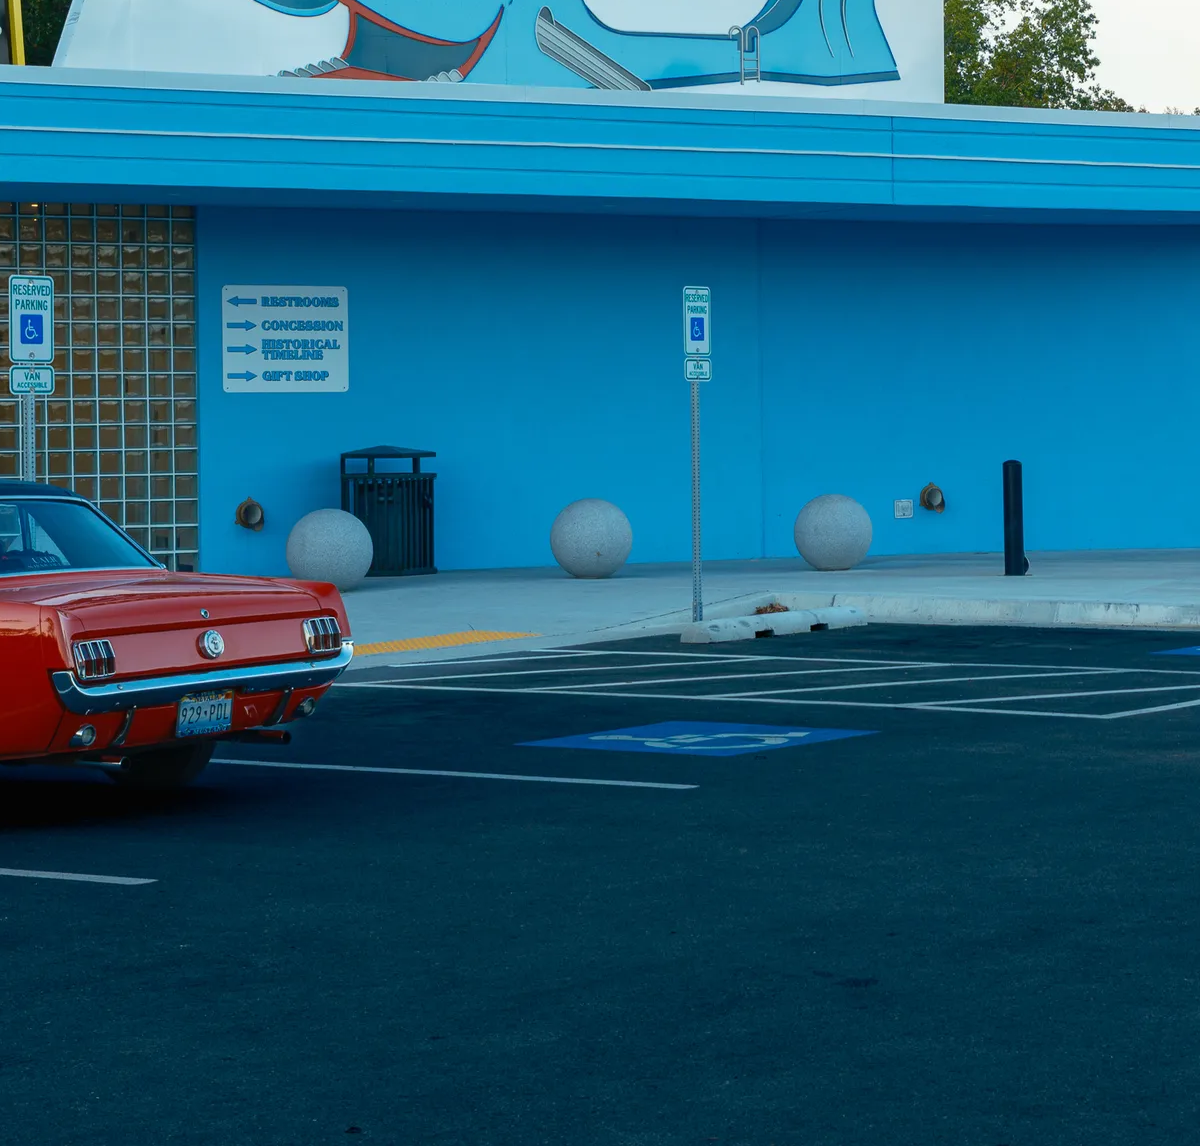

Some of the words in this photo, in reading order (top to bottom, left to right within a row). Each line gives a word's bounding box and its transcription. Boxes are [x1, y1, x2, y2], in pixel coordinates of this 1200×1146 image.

[12, 284, 51, 296] RESERVED
[261, 296, 340, 308] RESTROOMS
[685, 294, 709, 303] RESERVED
[15, 299, 48, 311] PARKING
[687, 305, 707, 314] PARKING
[261, 320, 344, 331] CONCESSION
[261, 339, 341, 350] HISTORICAL
[261, 349, 324, 361] TIMELINE
[23, 372, 41, 381] VAN
[261, 370, 293, 382] GIFT
[294, 370, 330, 382] SHOP
